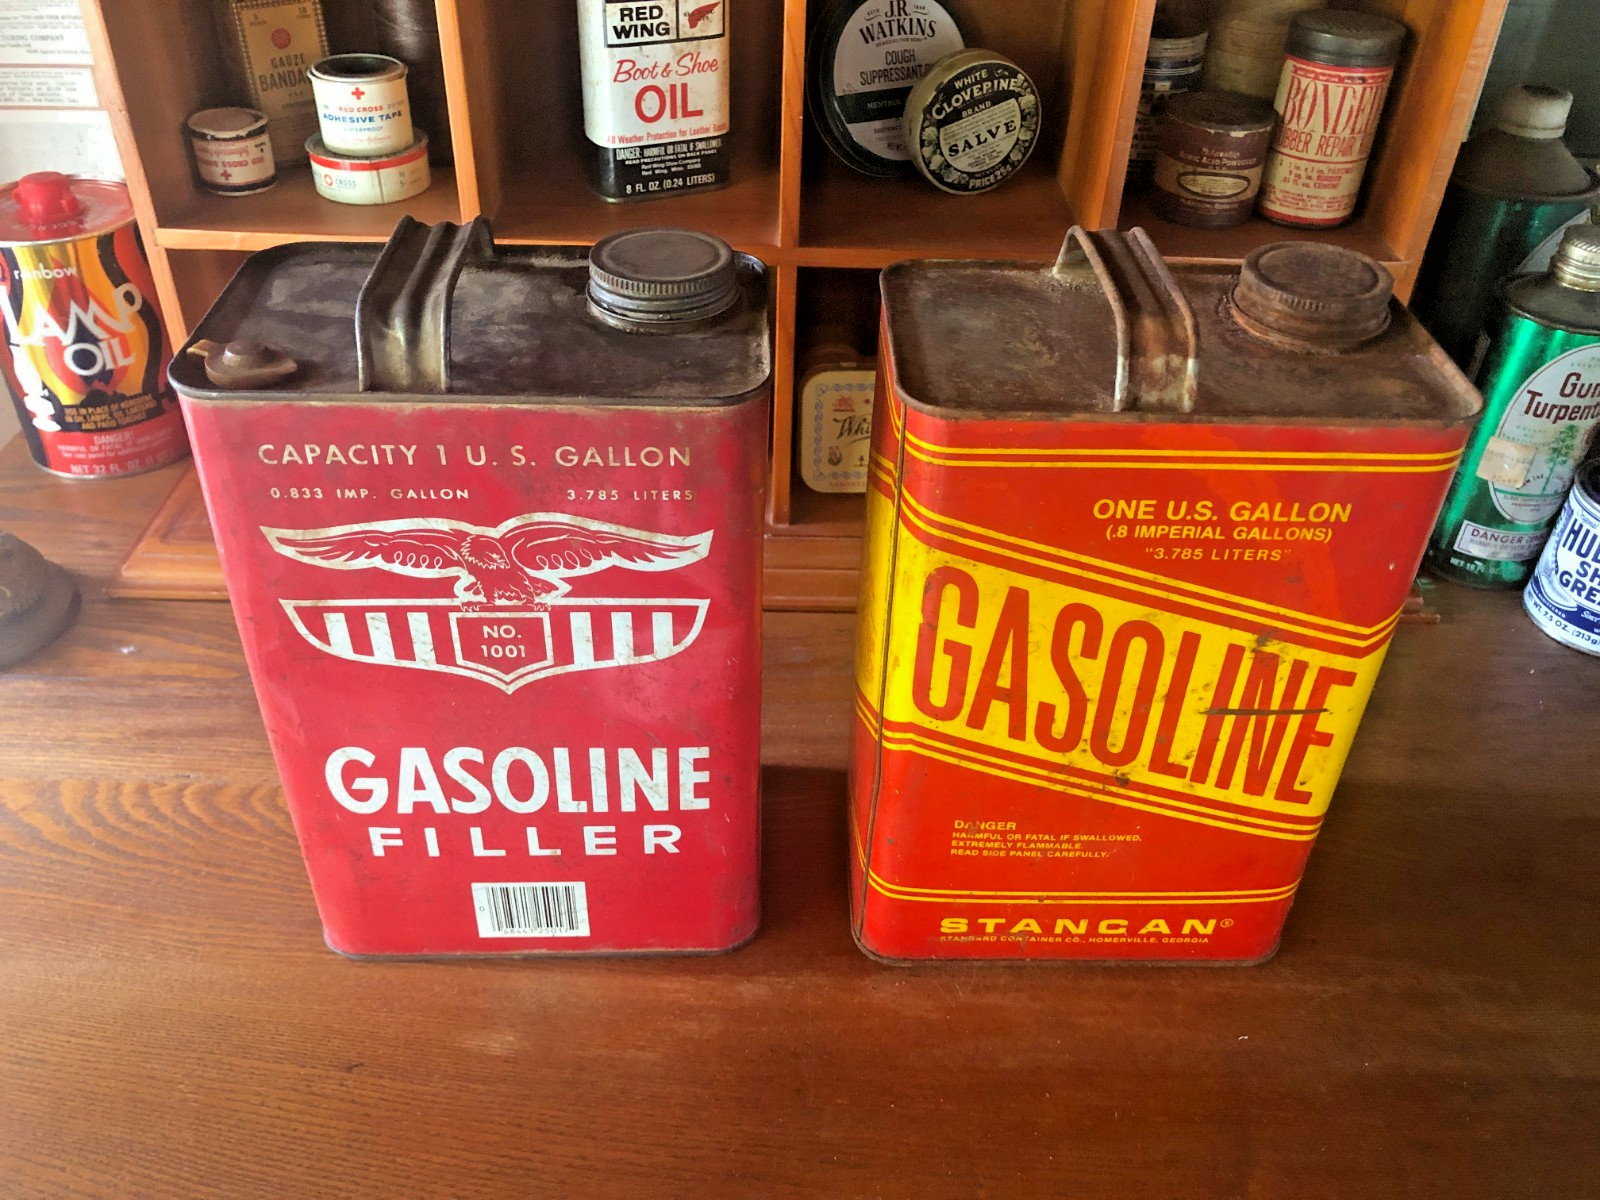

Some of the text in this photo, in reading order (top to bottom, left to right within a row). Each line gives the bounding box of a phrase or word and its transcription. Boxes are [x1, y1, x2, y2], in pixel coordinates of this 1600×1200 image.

[619, 5, 663, 22] RED
[612, 22, 671, 39] WING
[859, 17, 937, 45] WATKINS
[885, 48, 916, 66] COUGH
[613, 51, 720, 83] Boot & Shoe
[860, 64, 922, 86] SUPPRESSANT
[954, 68, 989, 90] WHITE
[338, 105, 384, 113] RED CROSS
[634, 82, 704, 124] OIL
[961, 100, 992, 118] BRAND
[323, 110, 402, 123] ADHESIVE TAPE
[618, 132, 644, 144] Weather
[646, 130, 677, 141] Protection
[679, 128, 687, 137] for
[689, 125, 711, 136] Leather
[948, 120, 1017, 158] SALVE
[626, 184, 632, 194] 8
[663, 178, 683, 189] (0.24
[686, 172, 715, 186] LITERS)
[968, 173, 994, 190] PRICE
[0, 282, 143, 347] LAMP
[64, 337, 136, 377] OIL
[258, 444, 417, 466] CAPACITY
[436, 444, 447, 466] 1
[554, 445, 691, 468] GALLON
[70, 464, 89, 476] NET
[93, 463, 106, 476] 32
[270, 487, 693, 501] 0.833 IMP. GALLON 3.785 LITERS
[1093, 498, 1352, 523] ONE U.S. GALLON
[1106, 524, 1333, 544] (.8 IMPERIAL GALLONS)
[1471, 528, 1524, 544] DANGER
[1543, 610, 1554, 622] 7.5
[1555, 619, 1570, 633] OZ.
[482, 624, 522, 639] NO.
[480, 644, 526, 658] 1001
[911, 564, 1357, 806] GASOLINE
[325, 746, 710, 814] GASOLINE
[954, 819, 1017, 831] DANGER
[367, 824, 682, 858] FILLER
[951, 840, 1084, 850] EXTREMELY FLAMMABLE.
[952, 832, 1004, 840] HARMFUL
[1006, 833, 1022, 841] OR
[1025, 833, 1056, 841] FATAL
[1073, 834, 1142, 842] SWALLOWED.
[950, 848, 979, 856] READ
[982, 849, 1006, 857] SIDE
[1047, 850, 1110, 858] CAREFULLY.
[1000, 935, 1062, 943] CONTAINER
